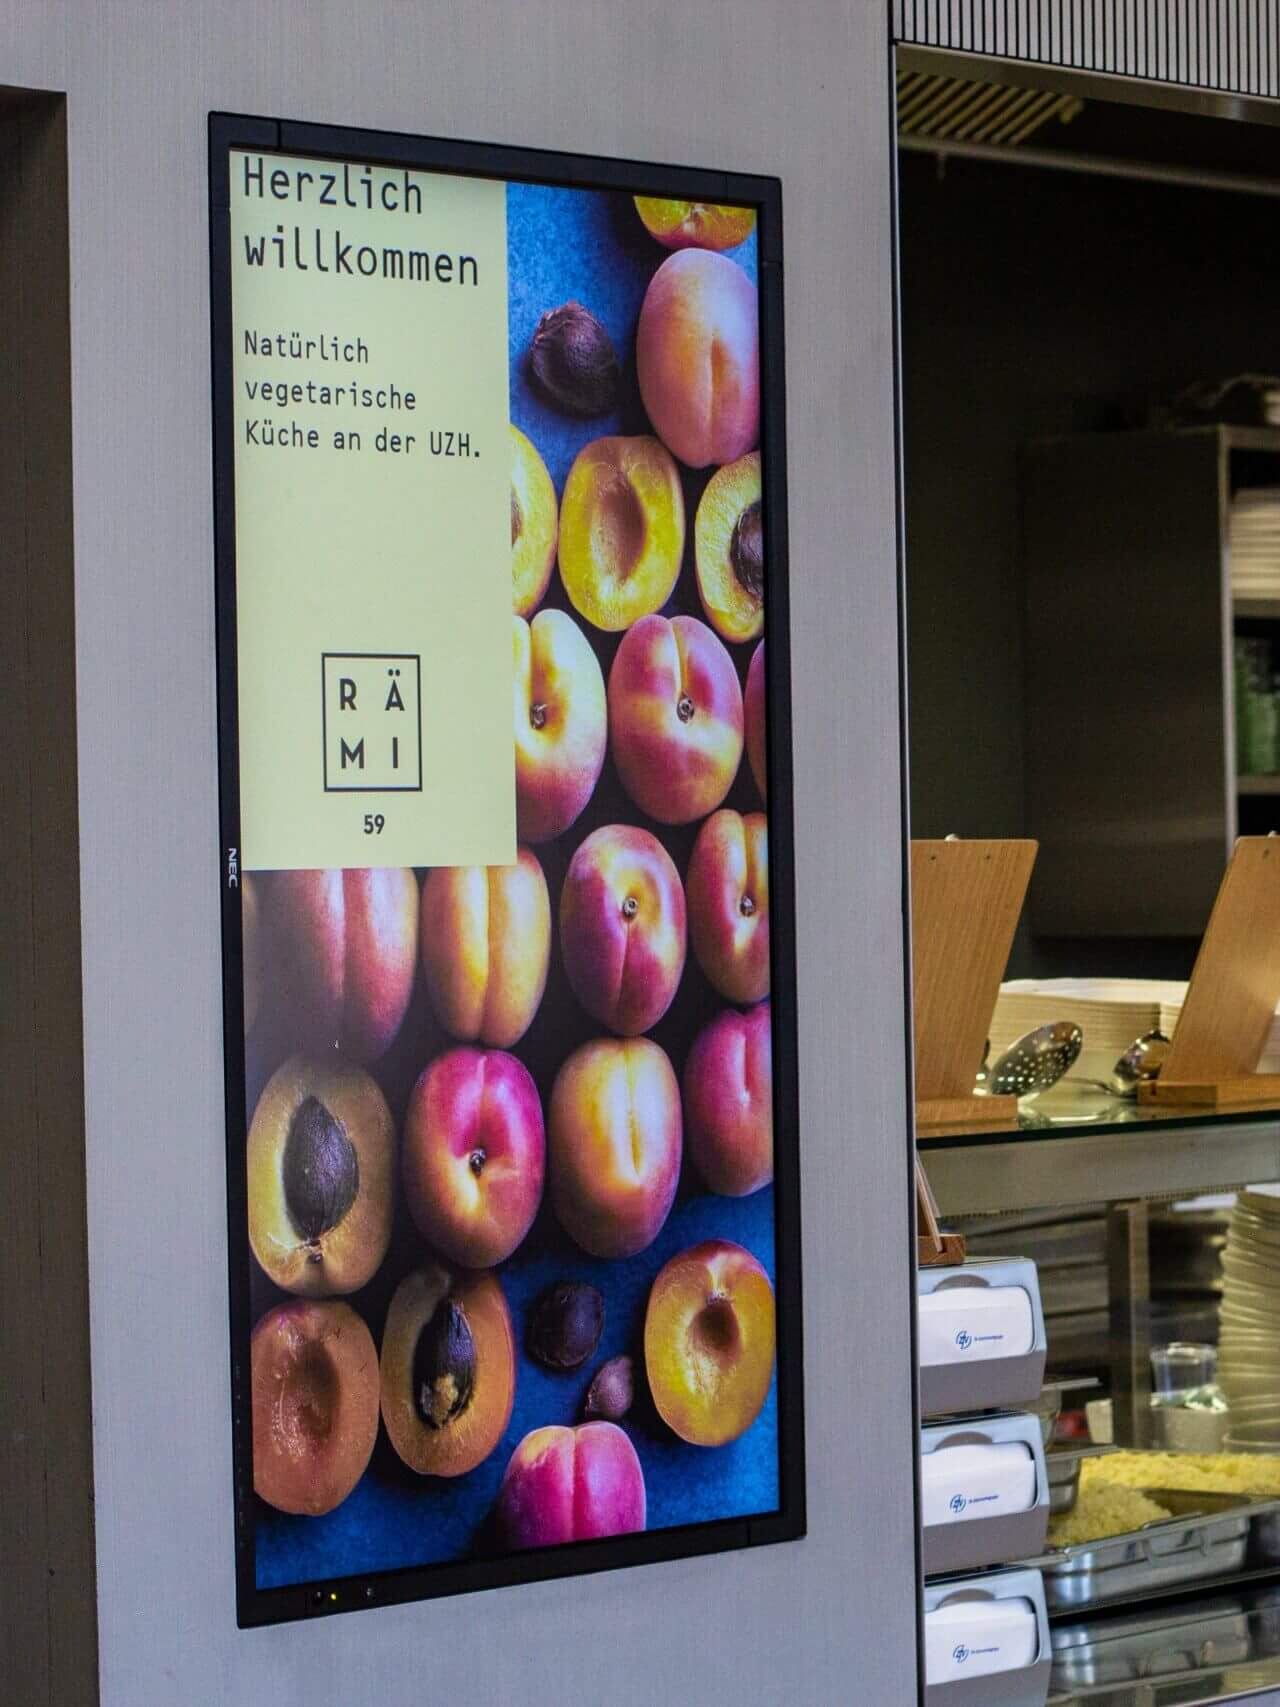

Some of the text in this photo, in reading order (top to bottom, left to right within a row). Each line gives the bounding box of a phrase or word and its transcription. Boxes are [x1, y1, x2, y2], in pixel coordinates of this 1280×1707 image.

[244, 155, 422, 214] Herzlich
[244, 224, 479, 286] willkommen
[244, 330, 369, 363] Natürlich
[245, 381, 417, 410] vegetarische
[245, 419, 481, 458] Küche an der UZH.
[363, 814, 385, 834] 59
[228, 847, 238, 889] NEC
